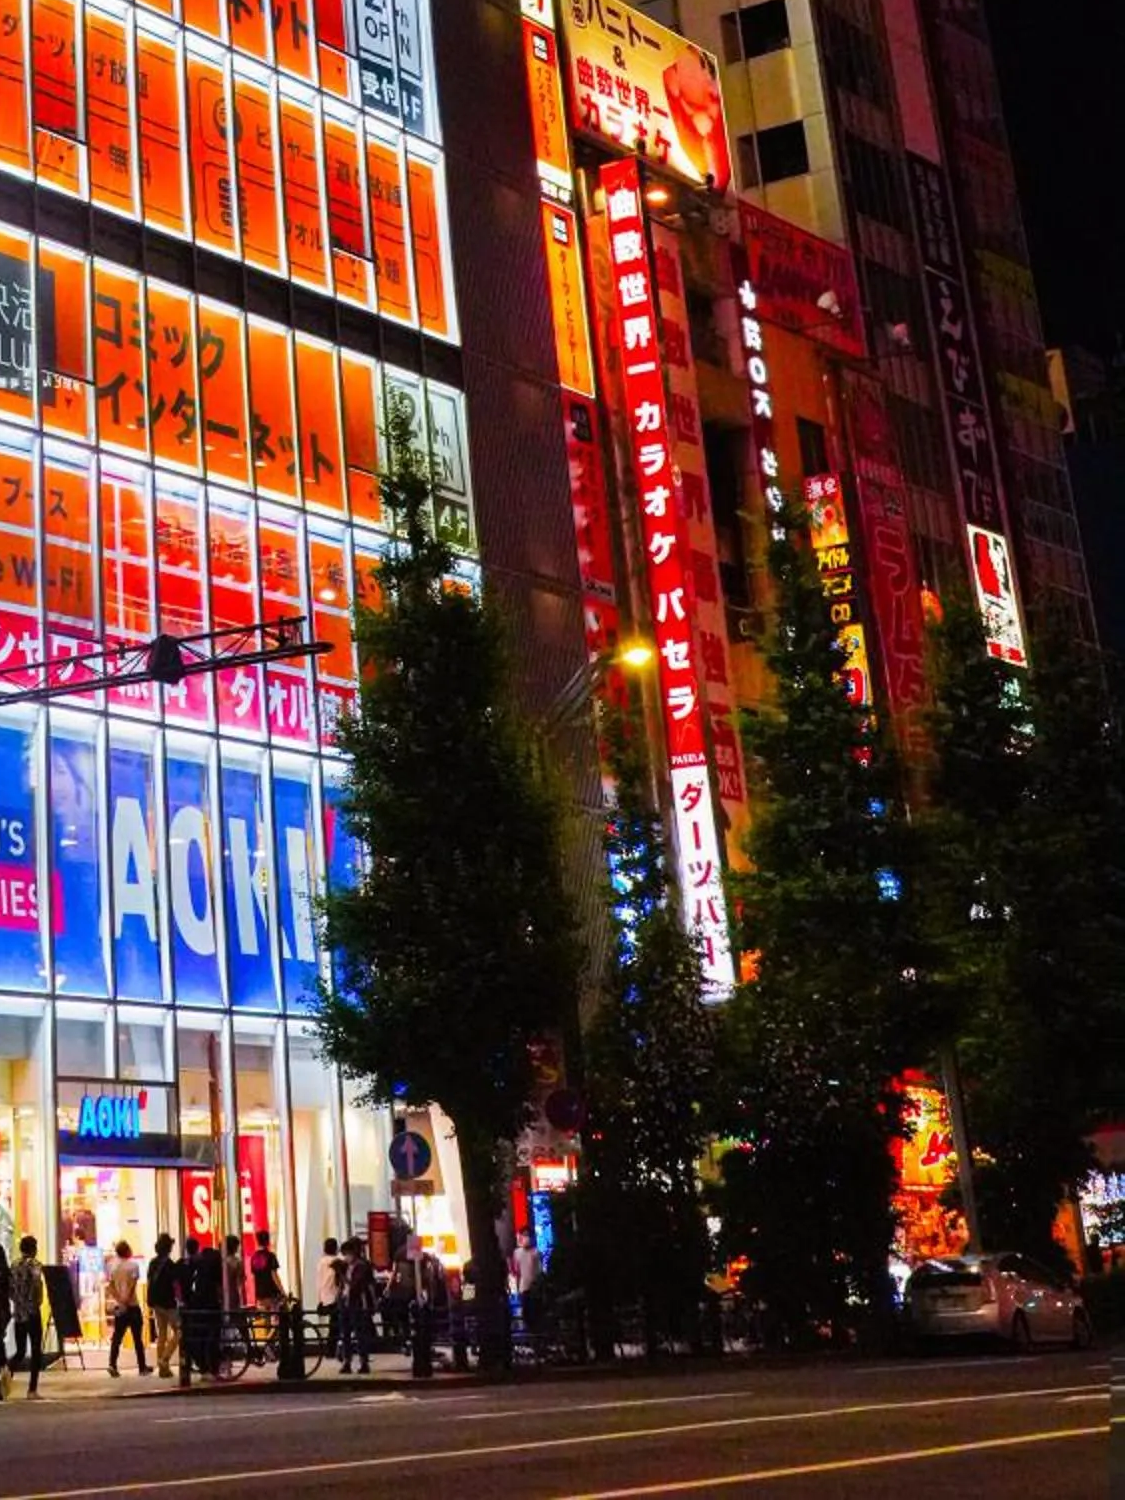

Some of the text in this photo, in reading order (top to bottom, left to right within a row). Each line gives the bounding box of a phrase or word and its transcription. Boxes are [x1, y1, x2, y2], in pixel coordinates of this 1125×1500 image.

[612, 45, 627, 71] &
[93, 293, 225, 382] コミック
[634, 402, 676, 565] カラオケ
[656, 586, 695, 721] パセラ
[107, 796, 317, 964] AOKI
[79, 1095, 140, 1139] AOKI
[192, 1184, 255, 1234] SE
